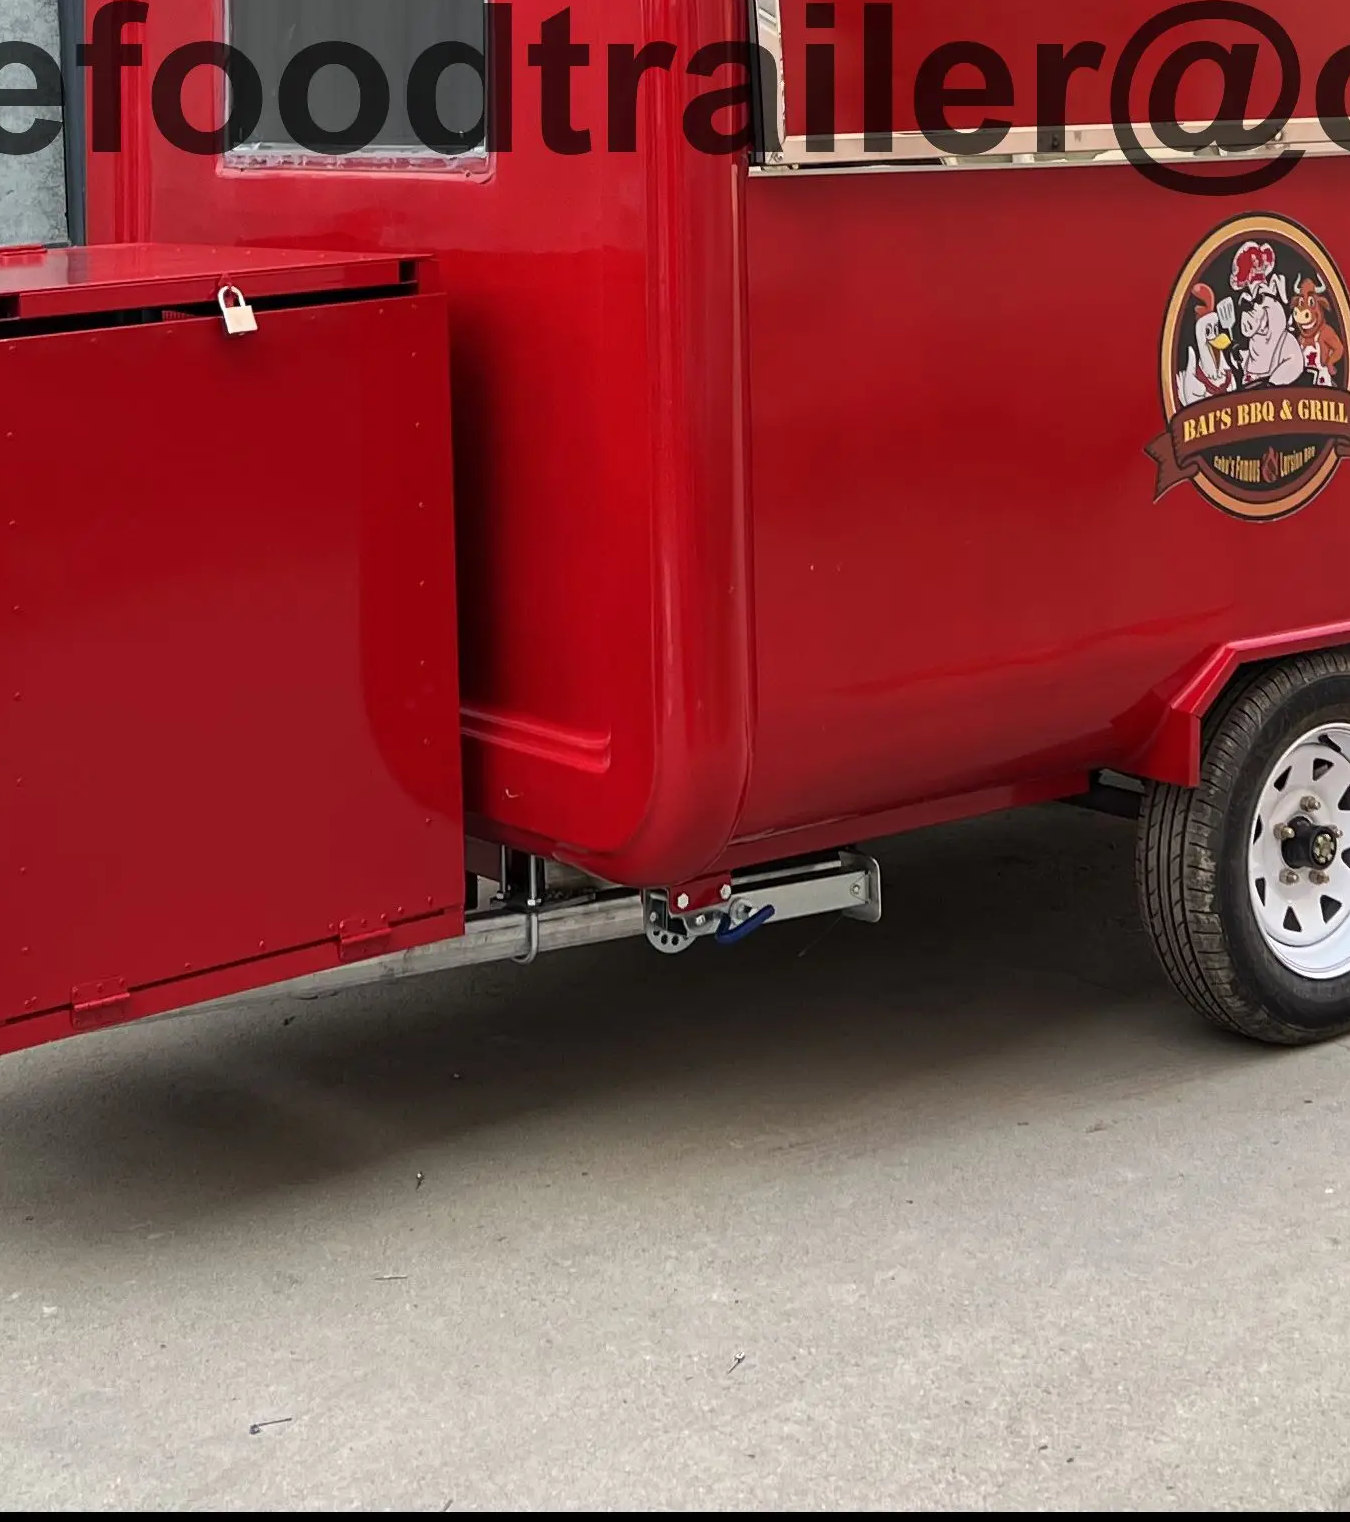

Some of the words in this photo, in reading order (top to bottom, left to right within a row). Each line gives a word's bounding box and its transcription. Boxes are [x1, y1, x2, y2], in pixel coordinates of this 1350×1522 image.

[1183, 407, 1232, 443] BAI'S
[1236, 400, 1275, 426] BBQ
[1279, 398, 1293, 421] &
[1297, 398, 1349, 424] GRILL
